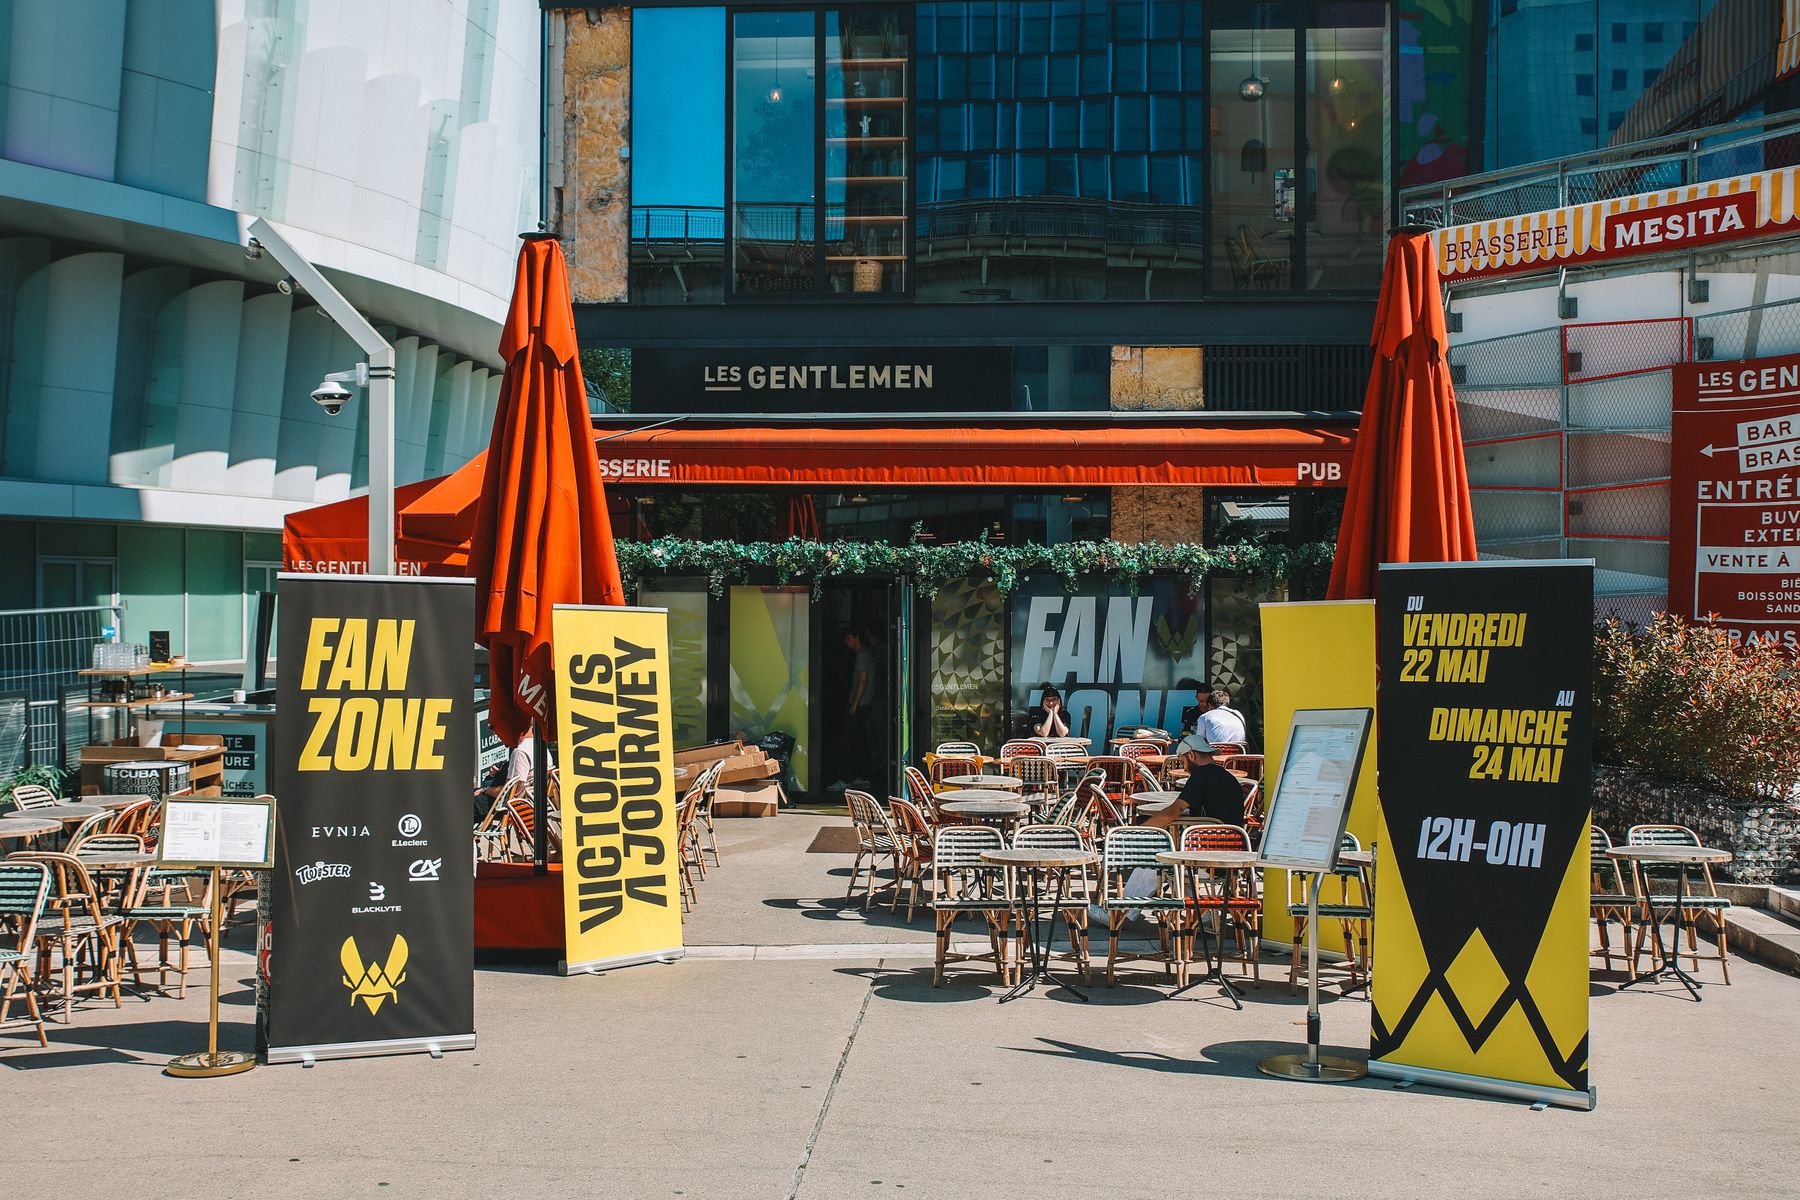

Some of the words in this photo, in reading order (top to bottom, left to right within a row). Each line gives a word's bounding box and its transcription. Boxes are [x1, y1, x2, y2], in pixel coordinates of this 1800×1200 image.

[1614, 204, 1746, 249] MESITA
[1445, 225, 1568, 263] BRASSERIE
[704, 366, 741, 383] LES
[748, 364, 933, 390] GENTLEMEN
[1699, 372, 1733, 388] LES
[1747, 420, 1792, 441] BAR
[1297, 462, 1341, 482] PUB
[291, 560, 312, 571] LES
[1707, 554, 1768, 568] VENTE
[1777, 551, 1790, 567] À
[1407, 596, 1423, 611] DU
[1738, 591, 1800, 601] BOISSONS
[1020, 596, 1154, 684] FAN
[1403, 613, 1527, 647] VENDREDI
[300, 617, 416, 691] FAN
[1400, 649, 1433, 682] 22
[1435, 649, 1489, 683] MAI
[569, 653, 614, 705] IS
[1556, 690, 1575, 707] AU
[298, 698, 453, 772] ZONE
[1429, 707, 1572, 746] DIMANCHE
[225, 756, 250, 767] URE
[613, 636, 665, 866] JOURNEY
[1469, 745, 1503, 780] 24
[1508, 746, 1564, 783] MAI
[119, 769, 160, 778] CUBA
[571, 711, 624, 935] VICTORY
[392, 839, 428, 847] E.Leclerc
[1416, 816, 1546, 868] 12H-01H
[352, 905, 402, 914] BLACKLYTE
